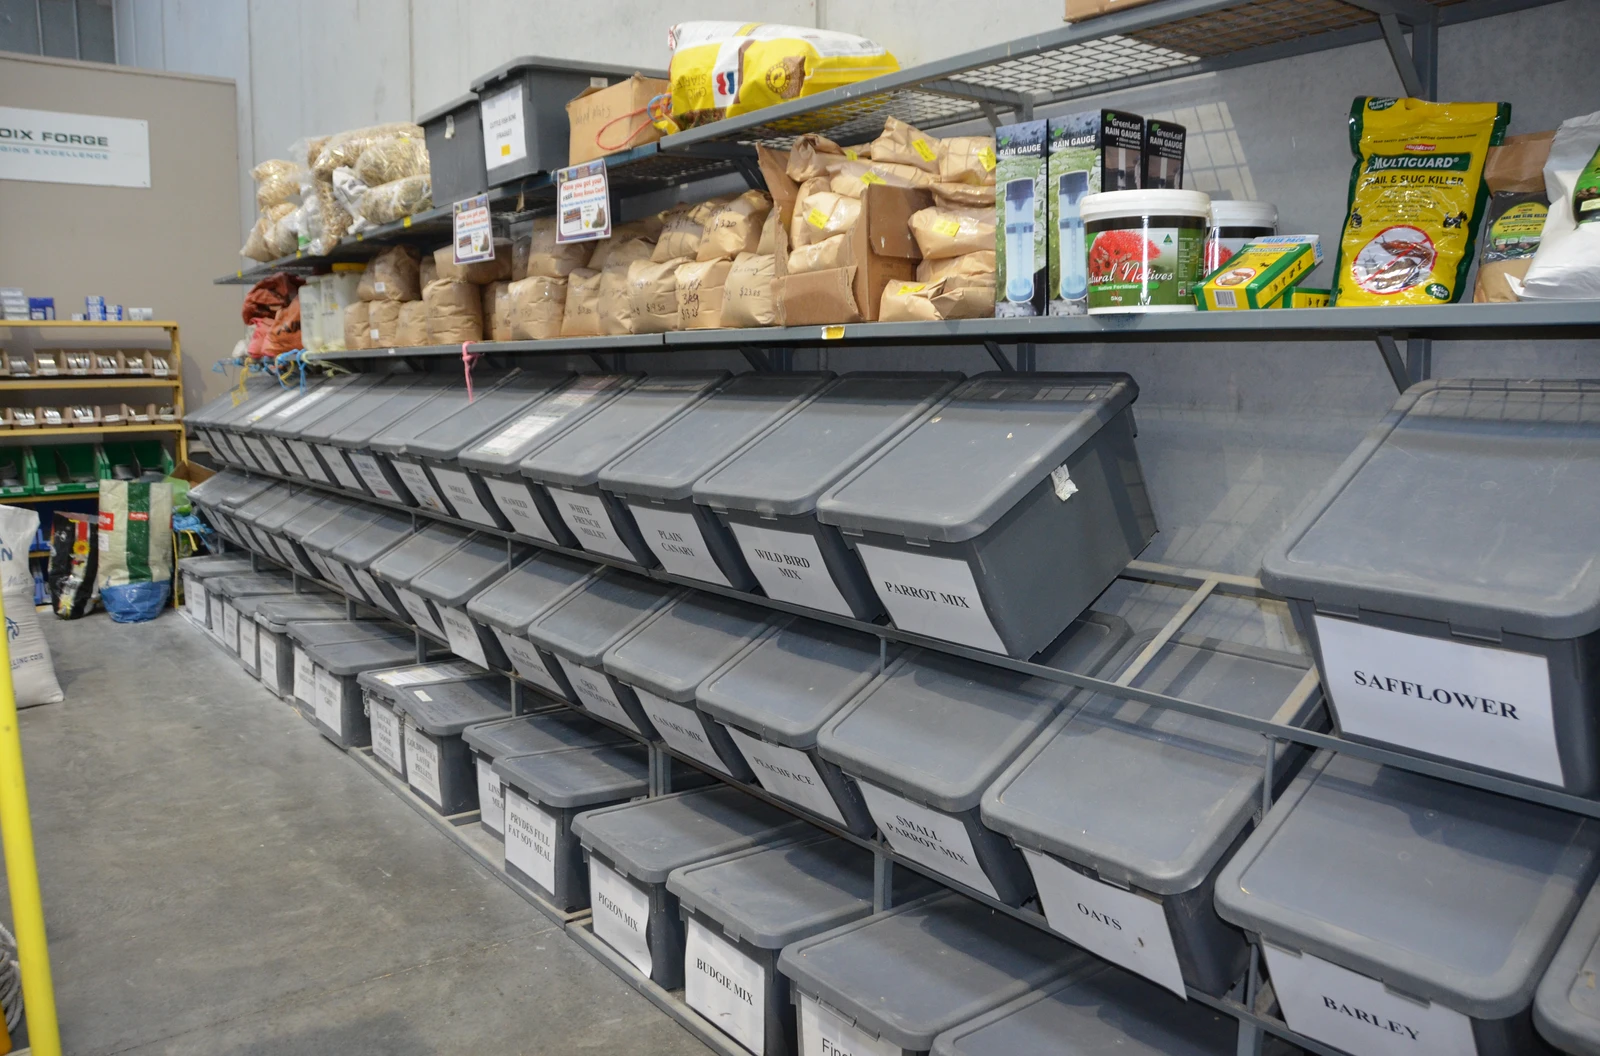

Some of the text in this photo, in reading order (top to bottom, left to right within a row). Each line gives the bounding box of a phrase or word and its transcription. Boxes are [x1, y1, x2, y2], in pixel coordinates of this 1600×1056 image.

[1112, 119, 1140, 130] GreenLeaf
[42, 132, 109, 146] FORGE
[1062, 128, 1094, 138] GreenLeaf
[1105, 127, 1141, 140] RAIN GAUGE
[1157, 129, 1183, 140] GreenLeaf
[1008, 137, 1040, 146] GreenLeaf
[1053, 135, 1095, 148] RAIN GAUGE
[1150, 137, 1183, 149] RAIN GAUGE
[34, 149, 108, 160] EXCELLENCE
[1000, 144, 1041, 156] RAIN GAUGE
[1400, 175, 1425, 184] SLUG
[1428, 176, 1464, 185] KILLER
[1088, 262, 1173, 283] atural Natives
[501, 496, 528, 508] SEAWEED
[512, 508, 529, 518] MEAL
[568, 503, 592, 516] WHITE
[572, 515, 601, 528] FRENCH
[580, 527, 607, 539] MILLET
[657, 529, 684, 542] PLAIN
[661, 542, 695, 557] CANARY
[755, 548, 810, 568] WILD BIRD
[778, 567, 802, 580] MIX
[884, 581, 970, 609] PARROT MIX
[1354, 670, 1520, 720] SAFFLOWER
[653, 714, 704, 742] CANARY MIX
[406, 738, 425, 754] GOLDEN
[414, 763, 432, 780] PELLETS
[753, 756, 814, 786] PEACHFACE
[488, 782, 500, 796] LINS
[492, 797, 504, 811] MEA
[510, 812, 550, 847] PRYDES FULL
[896, 815, 942, 842] SMALL
[508, 824, 551, 862] FAT SOY MEAL
[885, 822, 968, 865] PARROT MIX
[598, 892, 639, 932] PIGEON MIX
[1077, 902, 1122, 931] OATS
[696, 957, 754, 1006] BUDGIE MIX
[1321, 995, 1420, 1041] BARLEY
